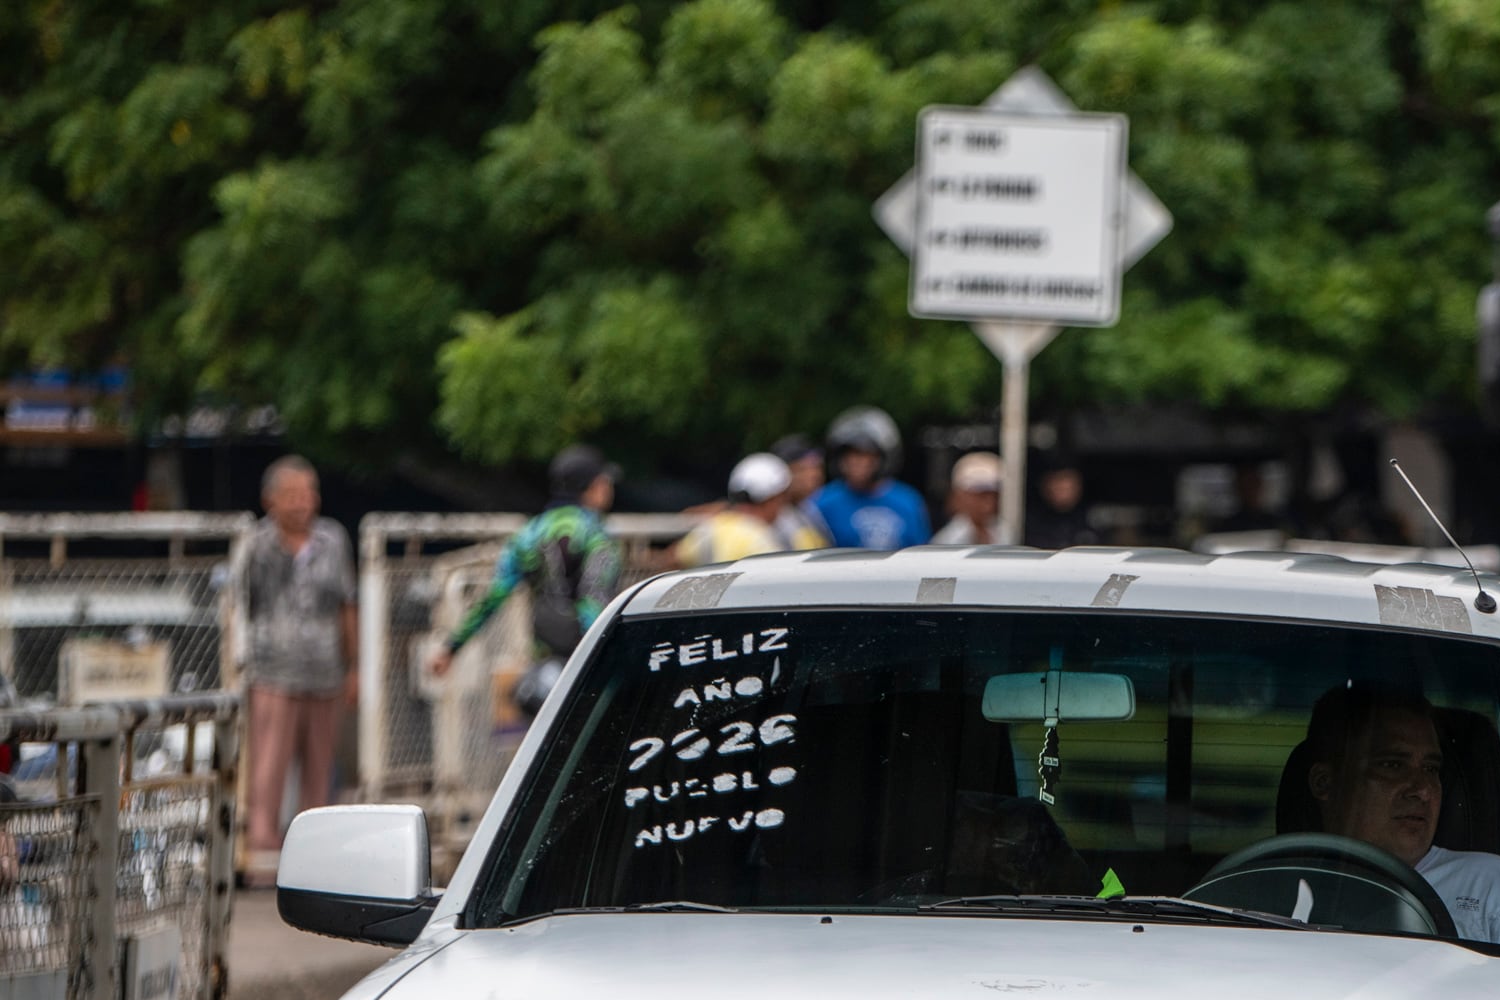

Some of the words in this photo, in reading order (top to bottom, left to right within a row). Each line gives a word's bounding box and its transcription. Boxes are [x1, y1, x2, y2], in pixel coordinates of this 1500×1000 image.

[648, 628, 789, 672] FELIZ
[629, 714, 797, 771] 2026
[625, 766, 797, 807] PUEBLO
[634, 808, 785, 847] NUEVO
